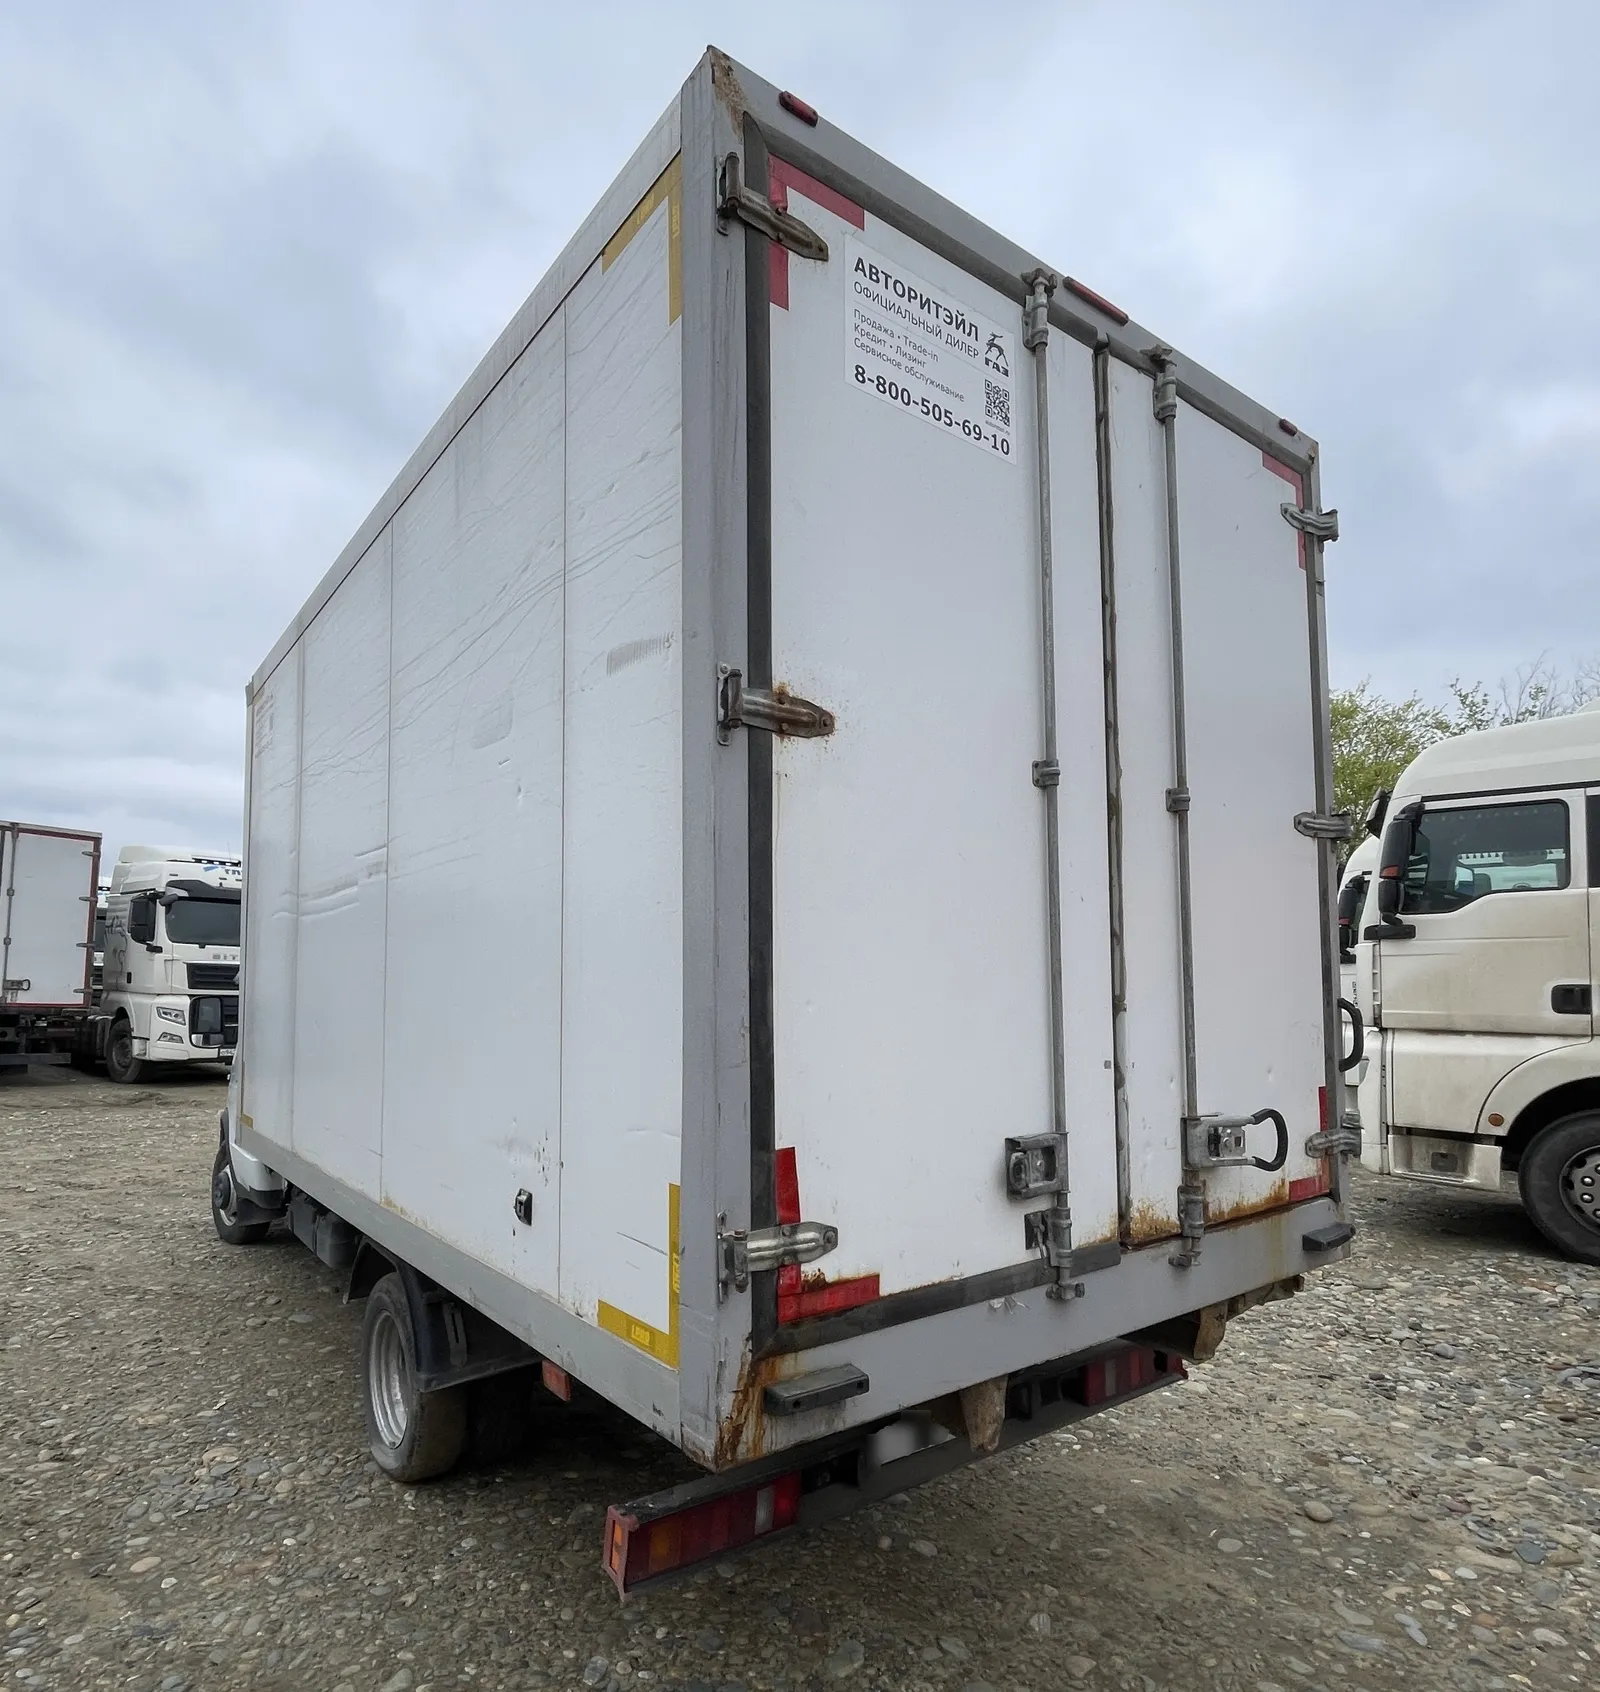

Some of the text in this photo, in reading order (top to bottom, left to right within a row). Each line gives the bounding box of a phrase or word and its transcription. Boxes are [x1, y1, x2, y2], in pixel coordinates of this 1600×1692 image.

[854, 257, 979, 342] АВТОРИТЭЙЛ
[854, 281, 979, 358] ОФИЦИАЛЬНЫЙ ДИЛЕР
[854, 309, 939, 362] Продажа Trade-in
[854, 323, 927, 368] Кредит Лизинг
[984, 357, 1009, 378] ГАЗ
[854, 338, 965, 402] Сервисное обслуживание
[854, 364, 1010, 456] 8-800-505-69-10
